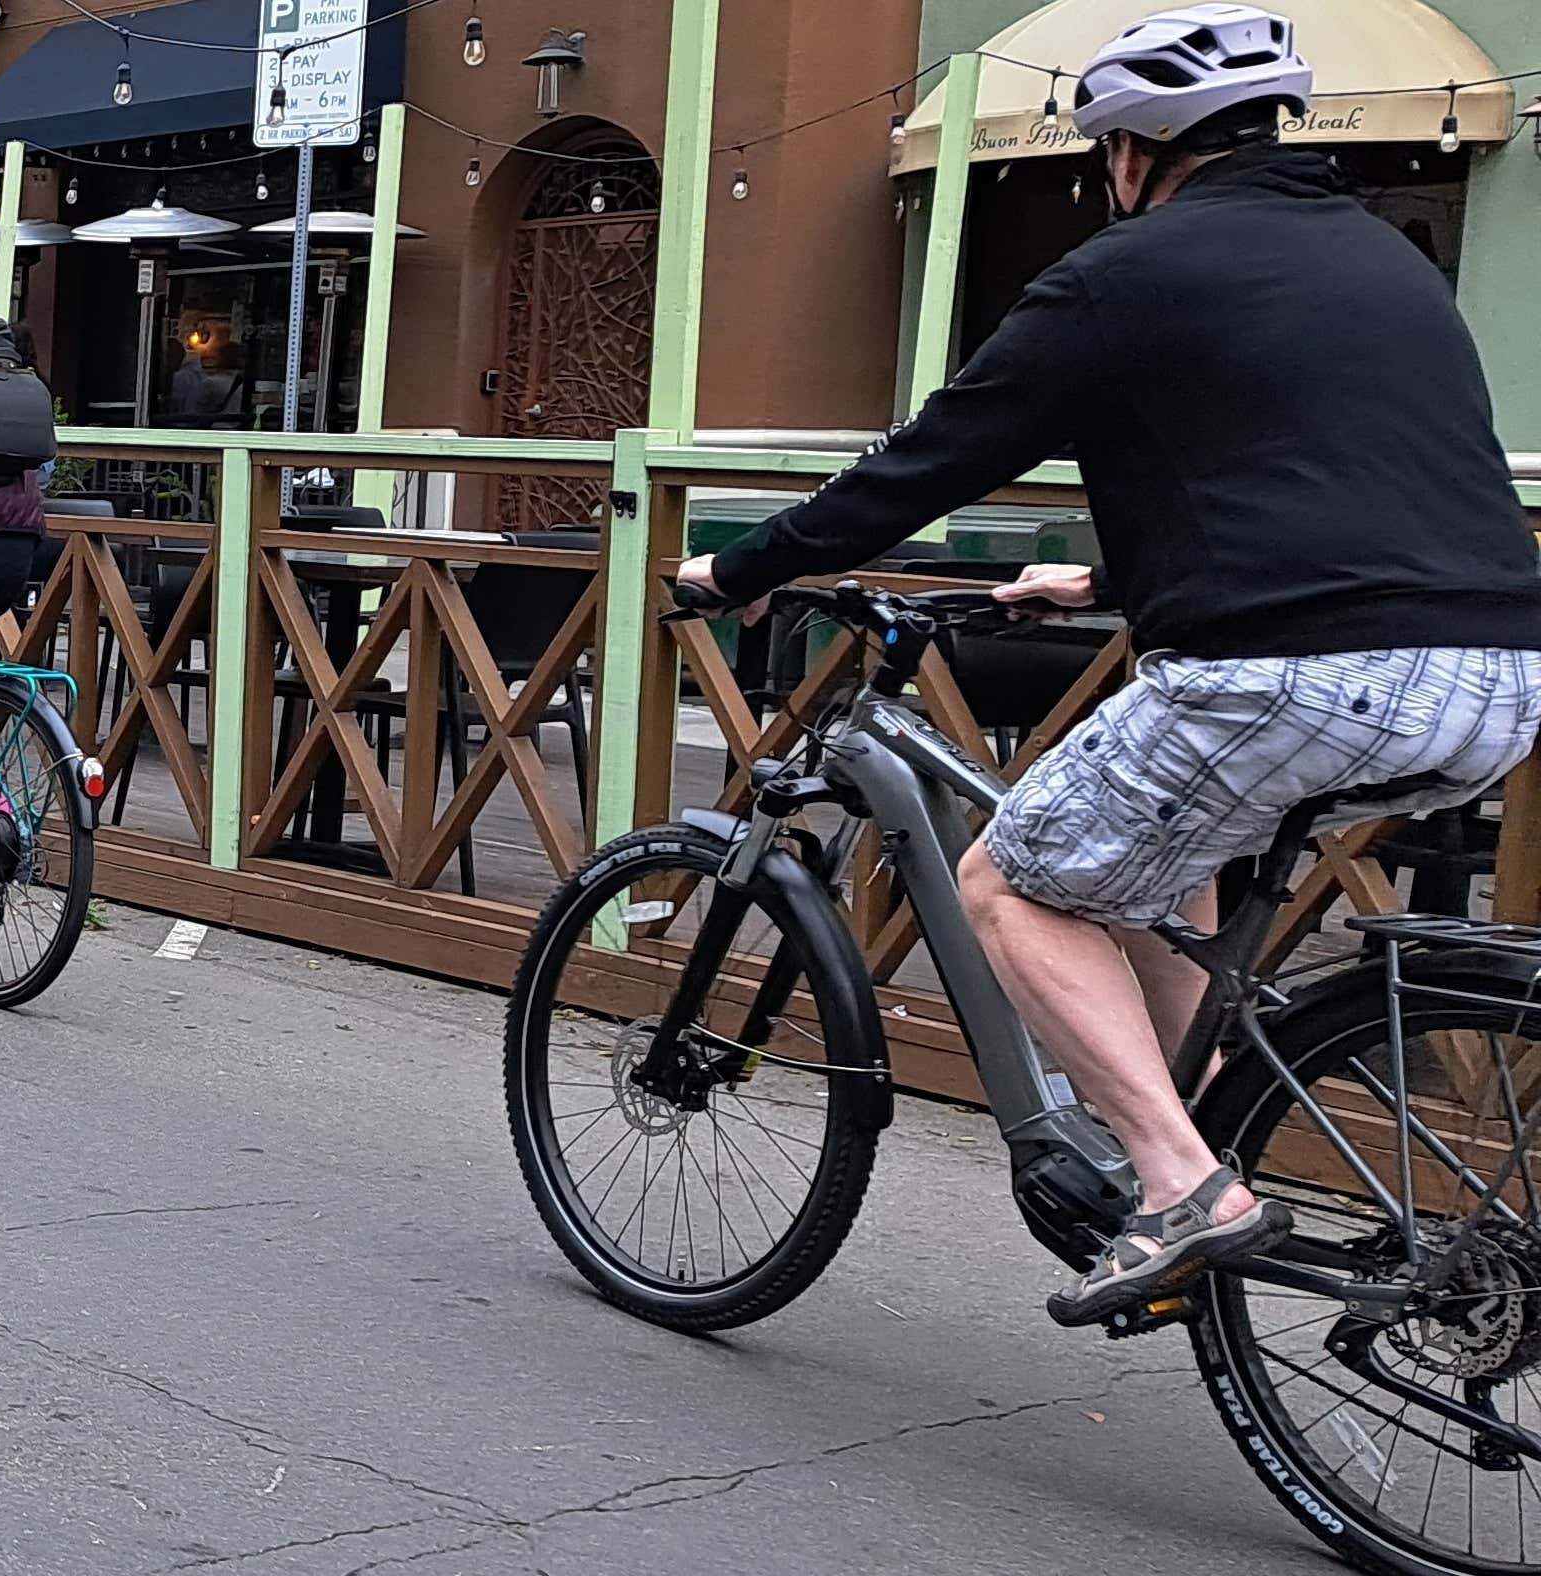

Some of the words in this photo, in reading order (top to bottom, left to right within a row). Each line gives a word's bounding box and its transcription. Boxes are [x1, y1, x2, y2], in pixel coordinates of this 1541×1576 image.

[270, 0, 294, 28] P
[304, 9, 357, 25] PARKING
[294, 37, 331, 50] PARK
[269, 58, 278, 70] 2
[292, 54, 319, 69] PAY
[268, 75, 278, 88] 3
[292, 70, 351, 87] DISPLAY
[970, 128, 1019, 152] Buon
[1281, 105, 1363, 133] Steak
[1216, 1374, 1253, 1429] PEAK
[1248, 1434, 1345, 1535] GOODYEAR
